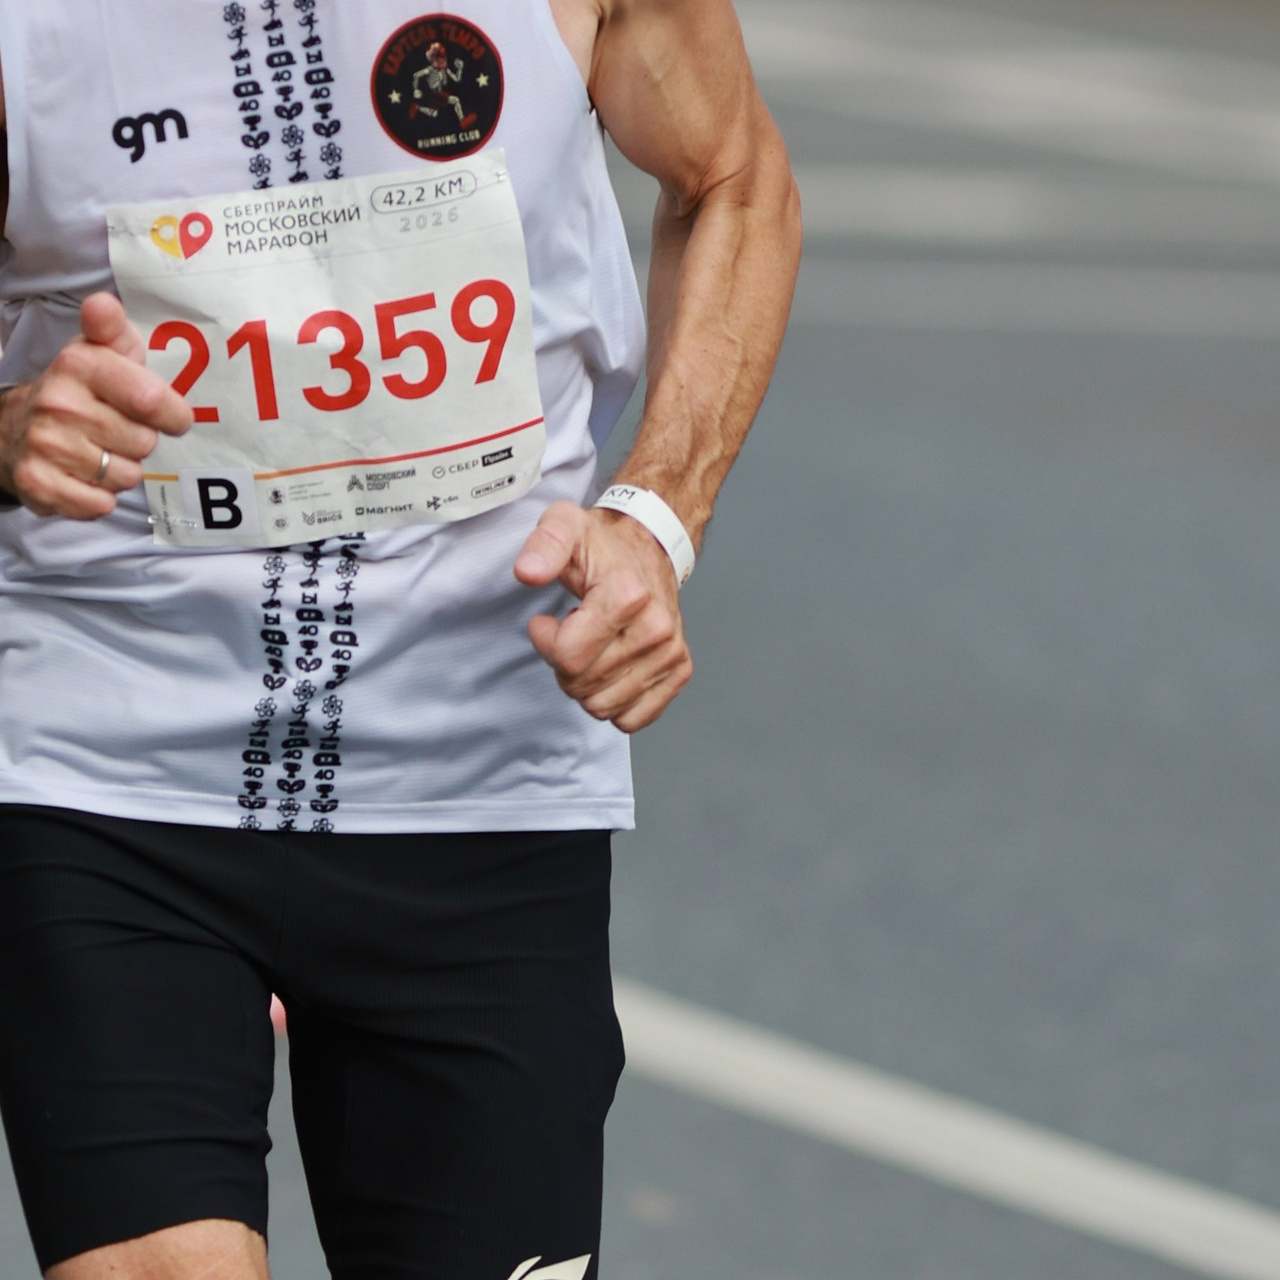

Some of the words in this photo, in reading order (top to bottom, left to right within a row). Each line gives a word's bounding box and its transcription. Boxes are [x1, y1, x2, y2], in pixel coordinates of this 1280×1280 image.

[417, 133, 457, 149] RUNNING
[459, 129, 480, 143] CLUB
[223, 196, 324, 218] СБЕРПРАЙМ
[382, 186, 426, 207] 42,2
[225, 205, 361, 237] МОСКОВСКИЙ
[227, 229, 328, 255] МАРАФОН
[148, 279, 516, 422] 21359
[197, 478, 242, 529] B
